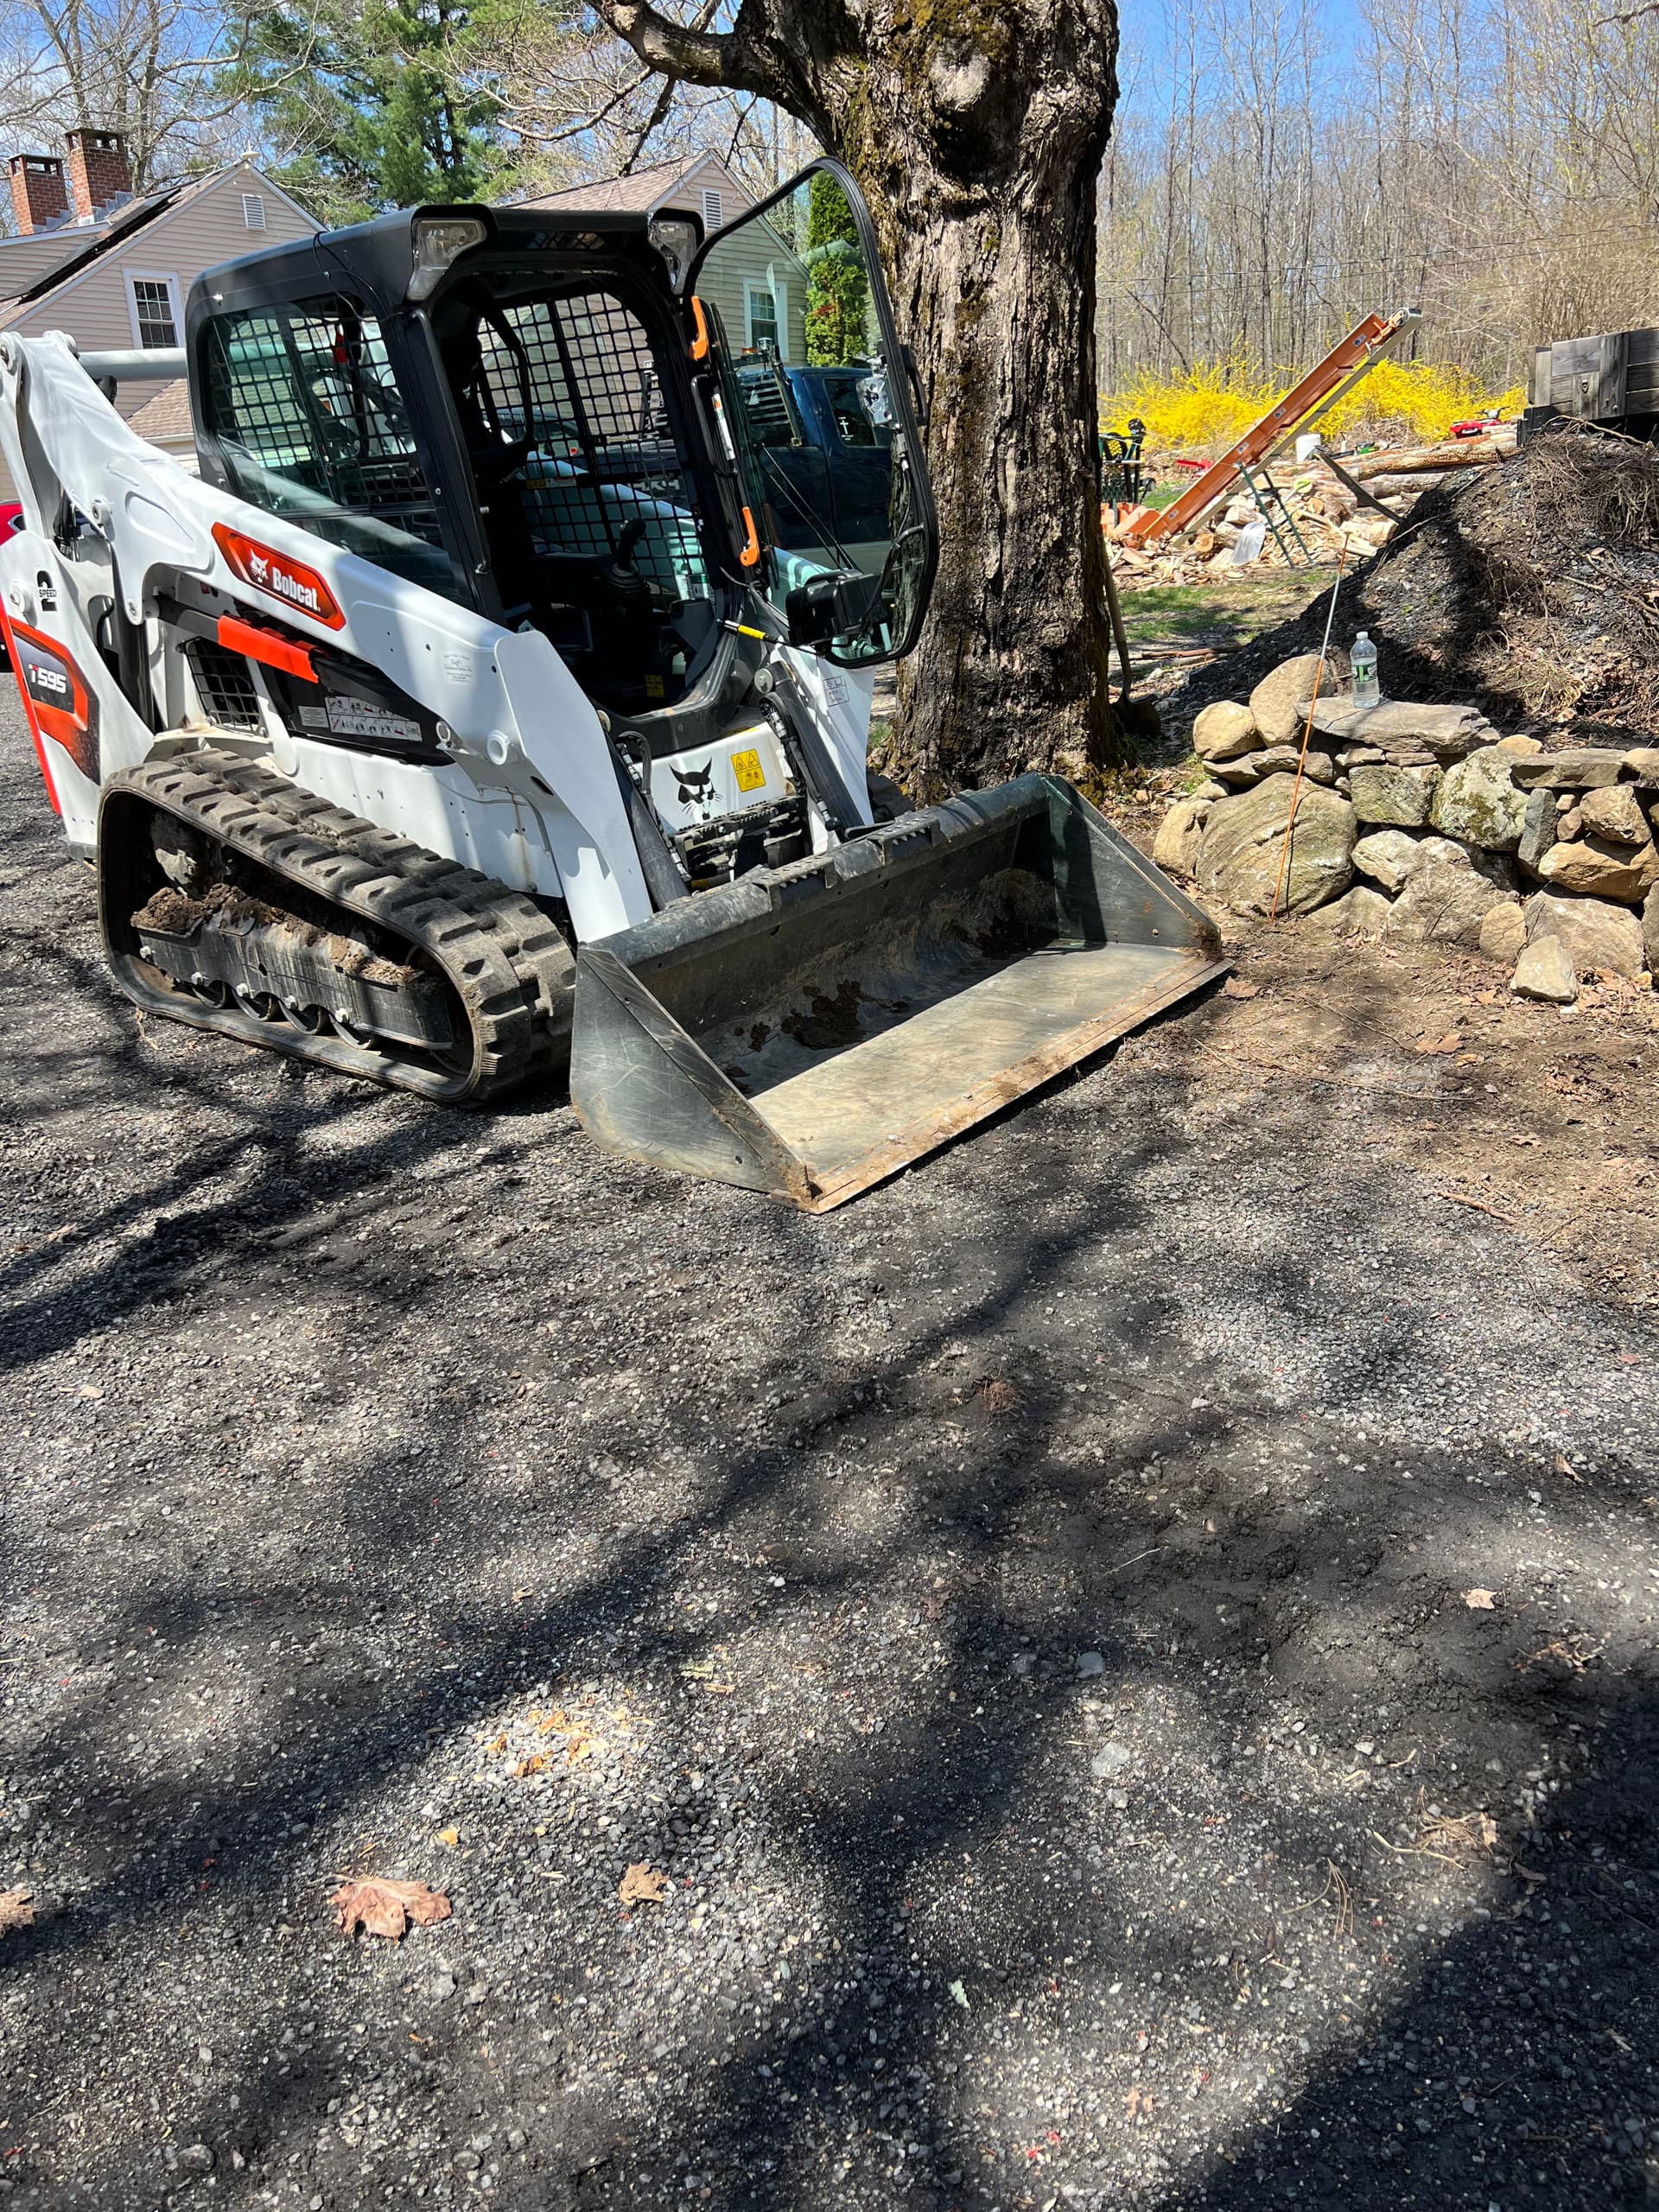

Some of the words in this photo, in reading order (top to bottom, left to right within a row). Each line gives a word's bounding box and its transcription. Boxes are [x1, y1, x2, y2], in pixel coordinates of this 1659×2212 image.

[36, 570, 58, 612] 2
[39, 588, 57, 598] SPEED
[272, 566, 319, 612] Bobcat
[28, 663, 67, 694] T595
